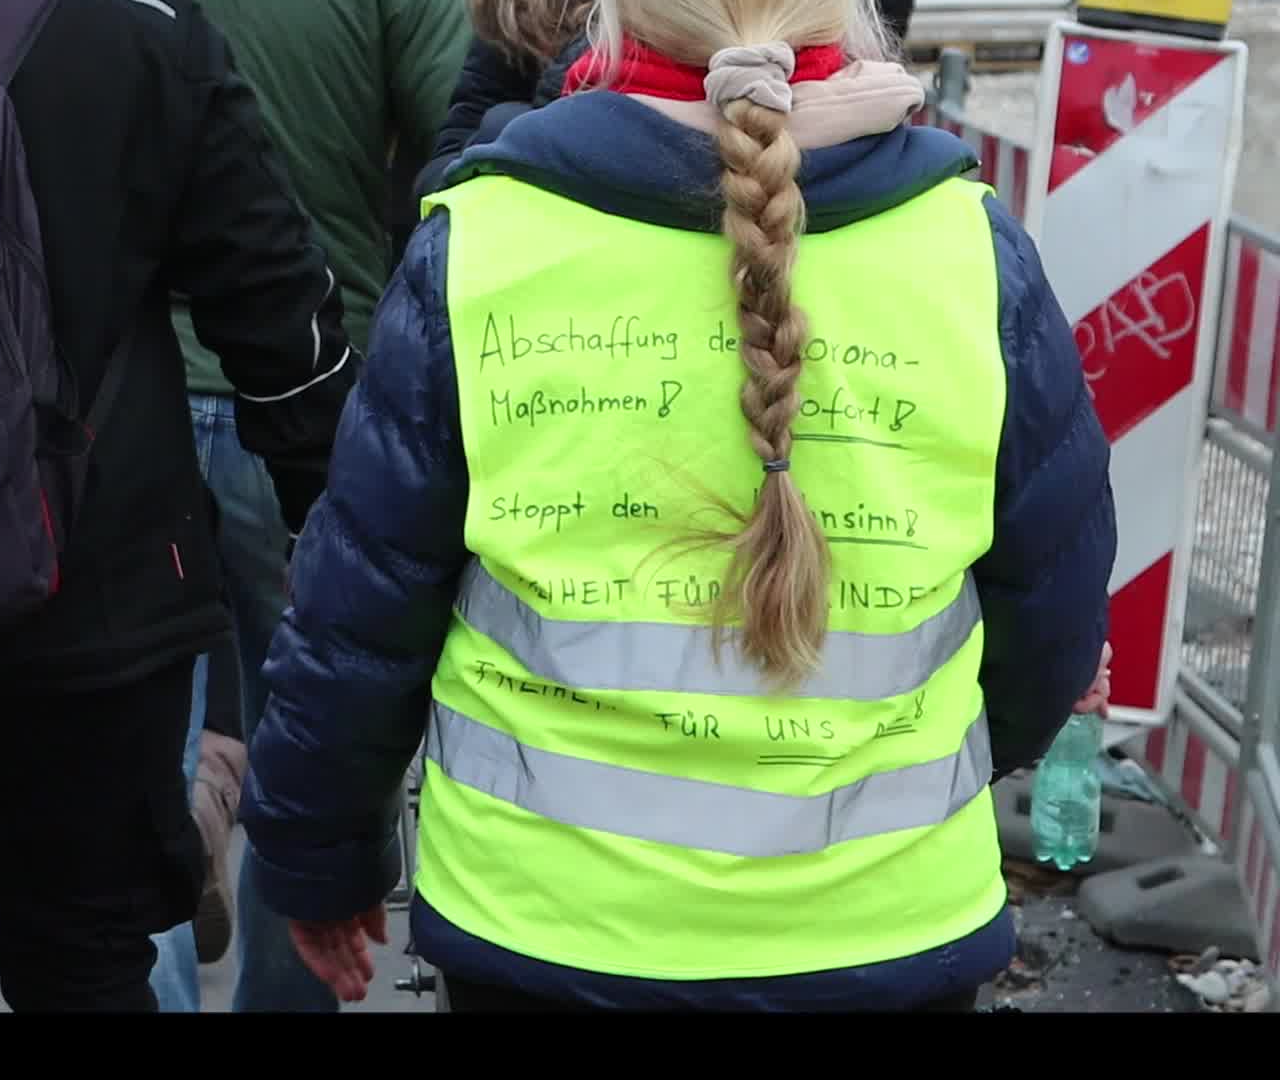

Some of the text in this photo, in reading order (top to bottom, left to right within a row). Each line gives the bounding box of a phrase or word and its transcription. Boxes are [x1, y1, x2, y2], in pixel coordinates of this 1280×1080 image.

[479, 311, 920, 374] Abschaffung de orona-
[799, 386, 917, 432] ofort!
[611, 492, 659, 520] den
[655, 711, 721, 740] FÜR
[764, 715, 836, 742] UNS
